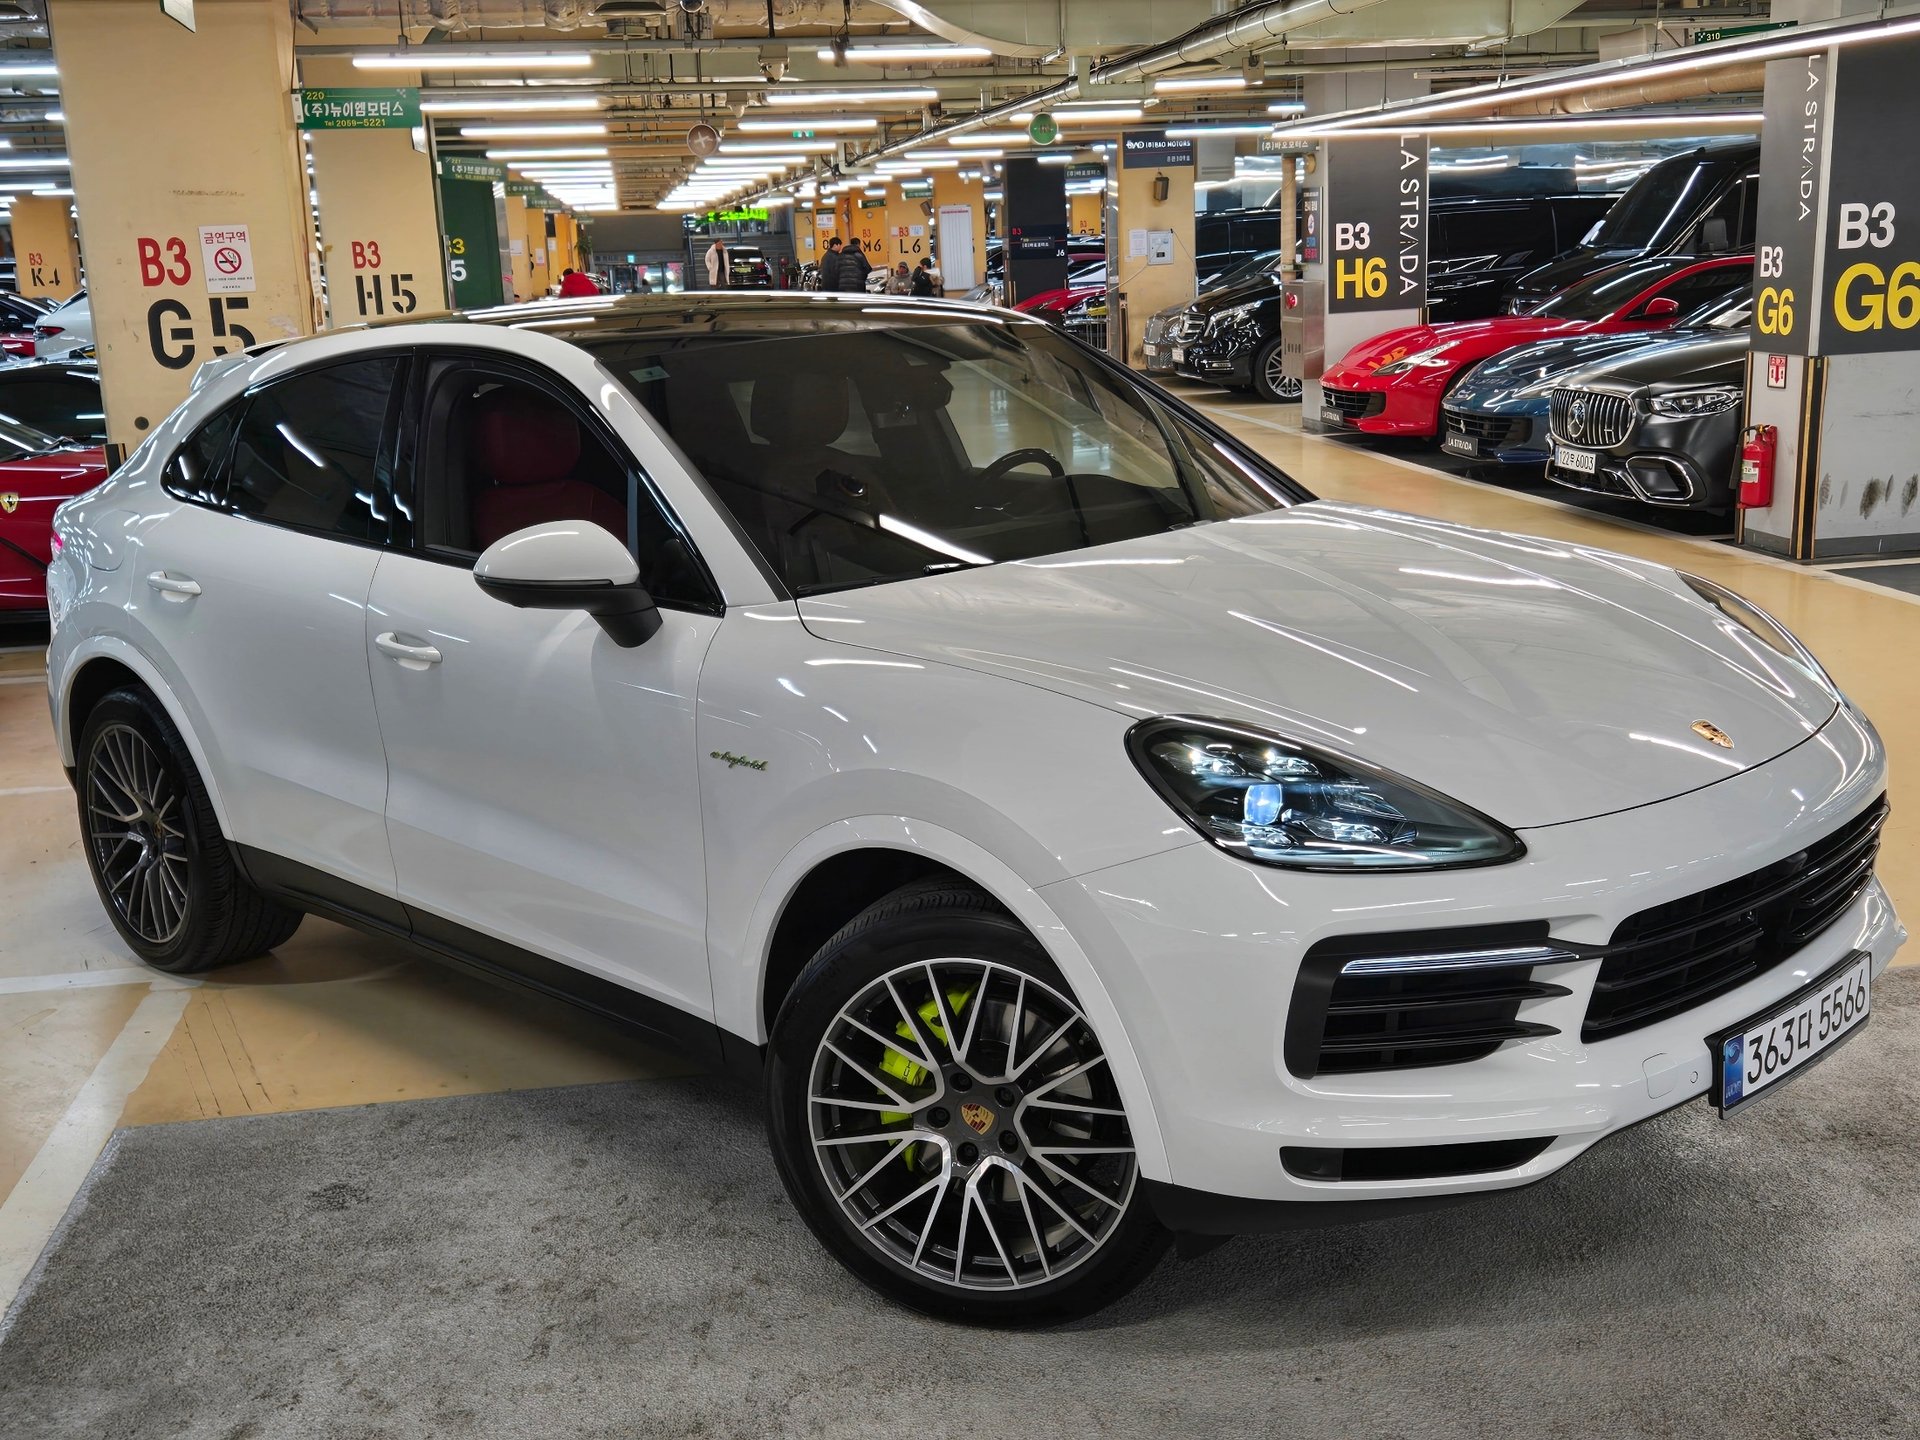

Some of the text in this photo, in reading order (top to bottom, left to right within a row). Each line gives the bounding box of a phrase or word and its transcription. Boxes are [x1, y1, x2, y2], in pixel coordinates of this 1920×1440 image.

[1706, 33, 1721, 41] 310
[306, 91, 325, 101] 220
[336, 118, 386, 127] 2059-5221
[1798, 54, 1821, 221] LA STRADA
[862, 228, 872, 238] B3
[898, 226, 910, 237] B3
[1335, 222, 1371, 251] B3
[1838, 201, 1897, 250] B3
[203, 231, 247, 244] 금연구역
[862, 238, 882, 253] M6
[899, 238, 921, 254] L6
[1400, 178, 1420, 296] STRADA
[28, 252, 43, 266] B3
[137, 237, 192, 287] B3
[351, 241, 382, 269] B3
[1056, 249, 1065, 257] J6
[1759, 246, 1784, 279] B3
[1336, 257, 1388, 299] H6
[1833, 261, 1920, 333] G6
[1757, 286, 1795, 336] G6
[1575, 454, 1594, 471] 6003
[1819, 968, 1866, 1041] 5566
